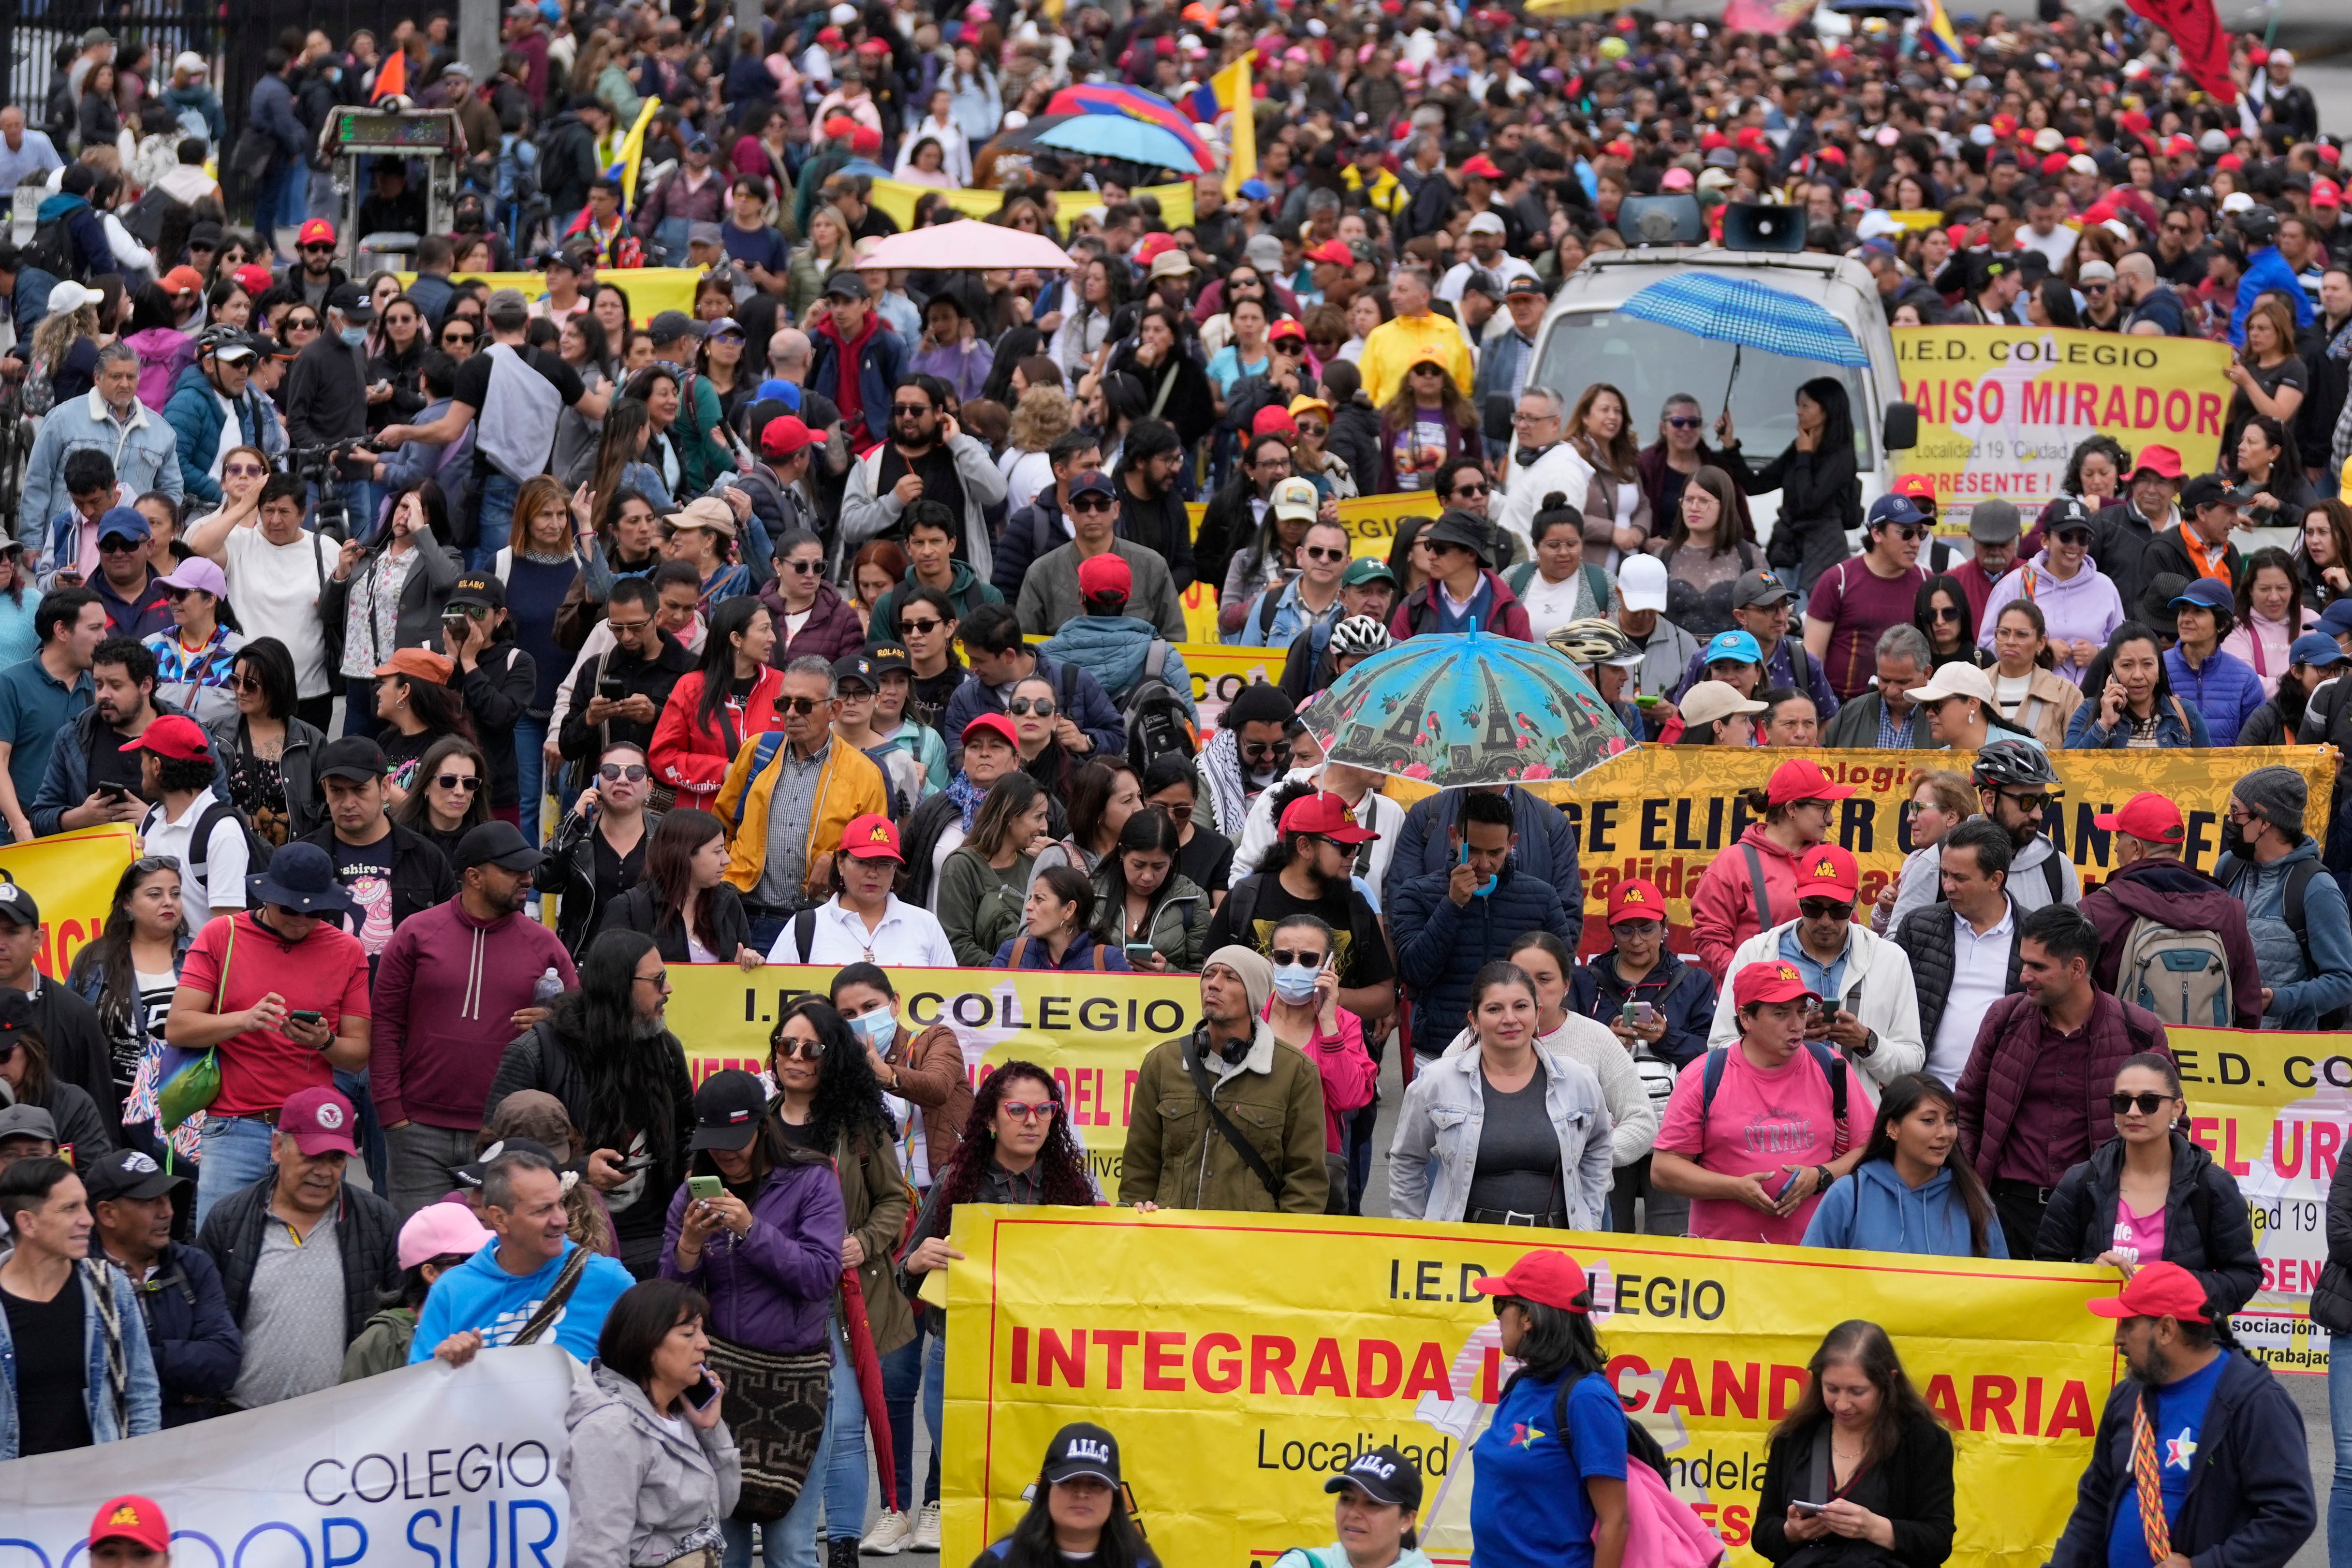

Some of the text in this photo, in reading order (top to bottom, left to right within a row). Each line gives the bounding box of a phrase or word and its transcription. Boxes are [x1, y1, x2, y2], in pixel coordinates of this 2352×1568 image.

[1900, 340, 2158, 368] I.E.D. COLEGIO
[2022, 381, 2221, 436] MIRADOR
[1916, 440, 1981, 459] Localidad
[1986, 441, 2004, 458] 19
[675, 772, 722, 791] Columbia
[908, 992, 1184, 1033] COLEGIO
[2292, 1202, 2318, 1231] 19
[2231, 1318, 2318, 1336] sociación
[1011, 1326, 1455, 1402] INTEGRADA
[305, 1439, 550, 1506] COLEGIO
